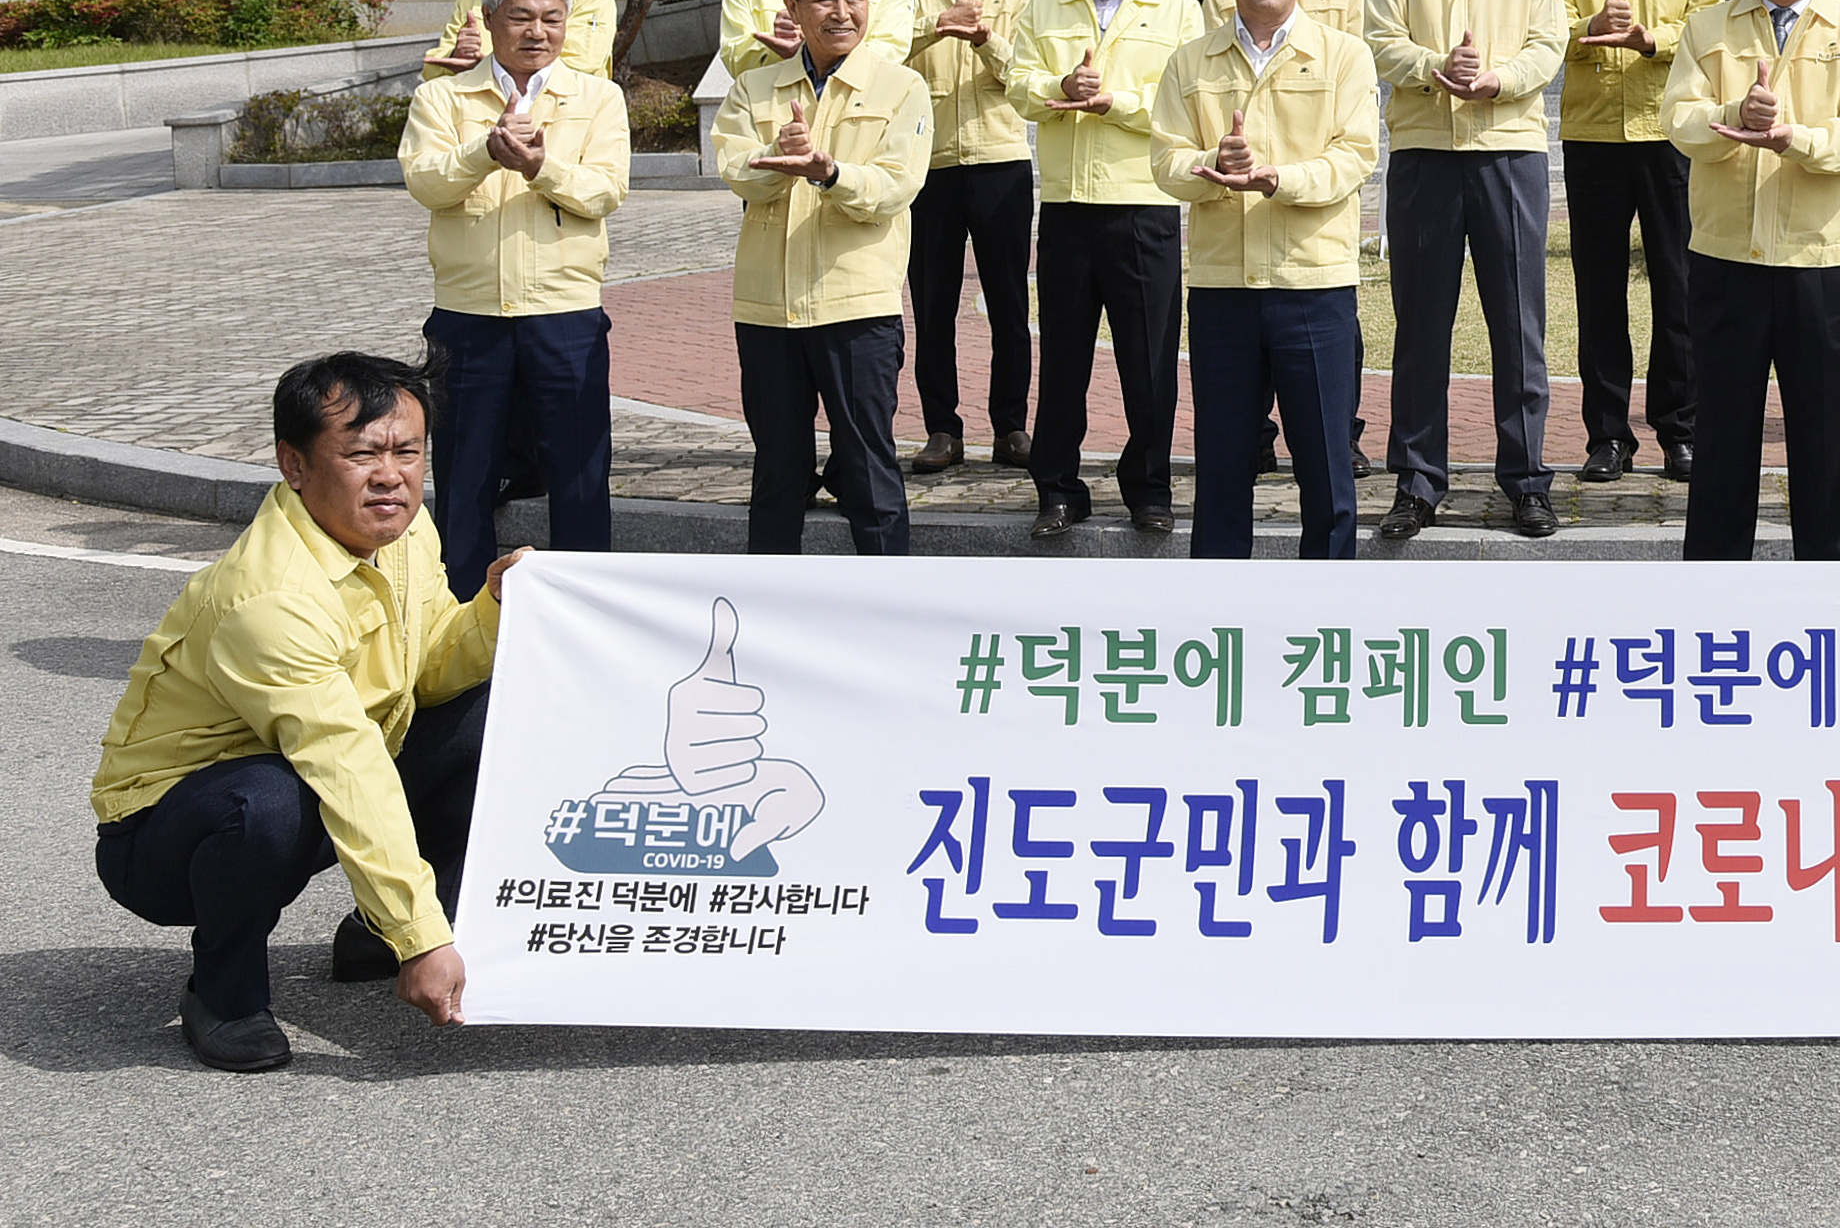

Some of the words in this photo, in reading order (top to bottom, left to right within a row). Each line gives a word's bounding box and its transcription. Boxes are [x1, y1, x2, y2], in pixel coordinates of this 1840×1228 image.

[956, 627, 1244, 727] #덕분에
[1281, 627, 1509, 728] 캠페인
[1552, 628, 1837, 729] #덕분에
[547, 801, 743, 849] #덕분에
[643, 853, 726, 869] COVID-19
[906, 776, 1357, 944] 진도군민과
[1391, 779, 1559, 944] 함께
[496, 878, 603, 910] #의료진
[612, 880, 698, 914] 덕분에
[709, 883, 870, 916] #감사합니다
[527, 922, 635, 955] #당신을
[642, 925, 786, 956] 존경합니다
